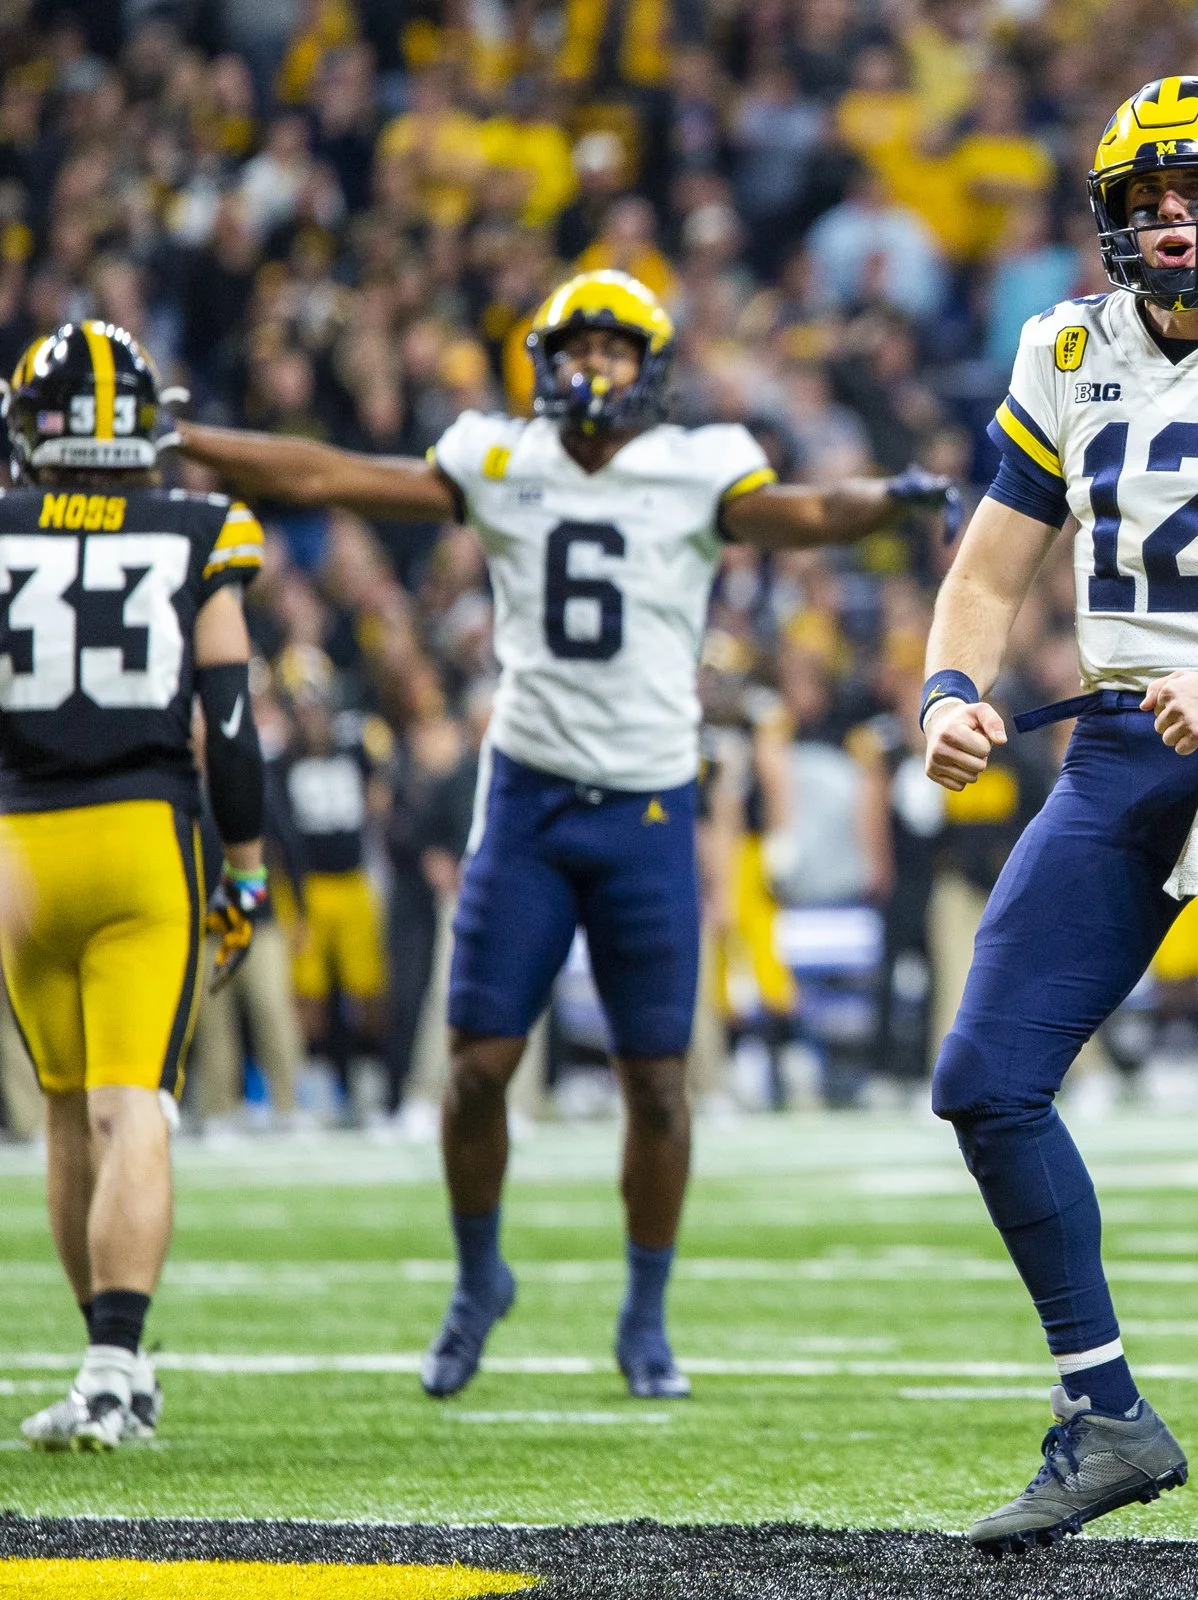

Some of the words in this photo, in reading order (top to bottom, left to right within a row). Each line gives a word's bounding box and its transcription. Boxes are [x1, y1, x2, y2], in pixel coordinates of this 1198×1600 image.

[1156, 141, 1177, 155] M
[38, 492, 127, 532] MOSS
[0, 532, 191, 711] 33
[543, 519, 626, 662] 6
